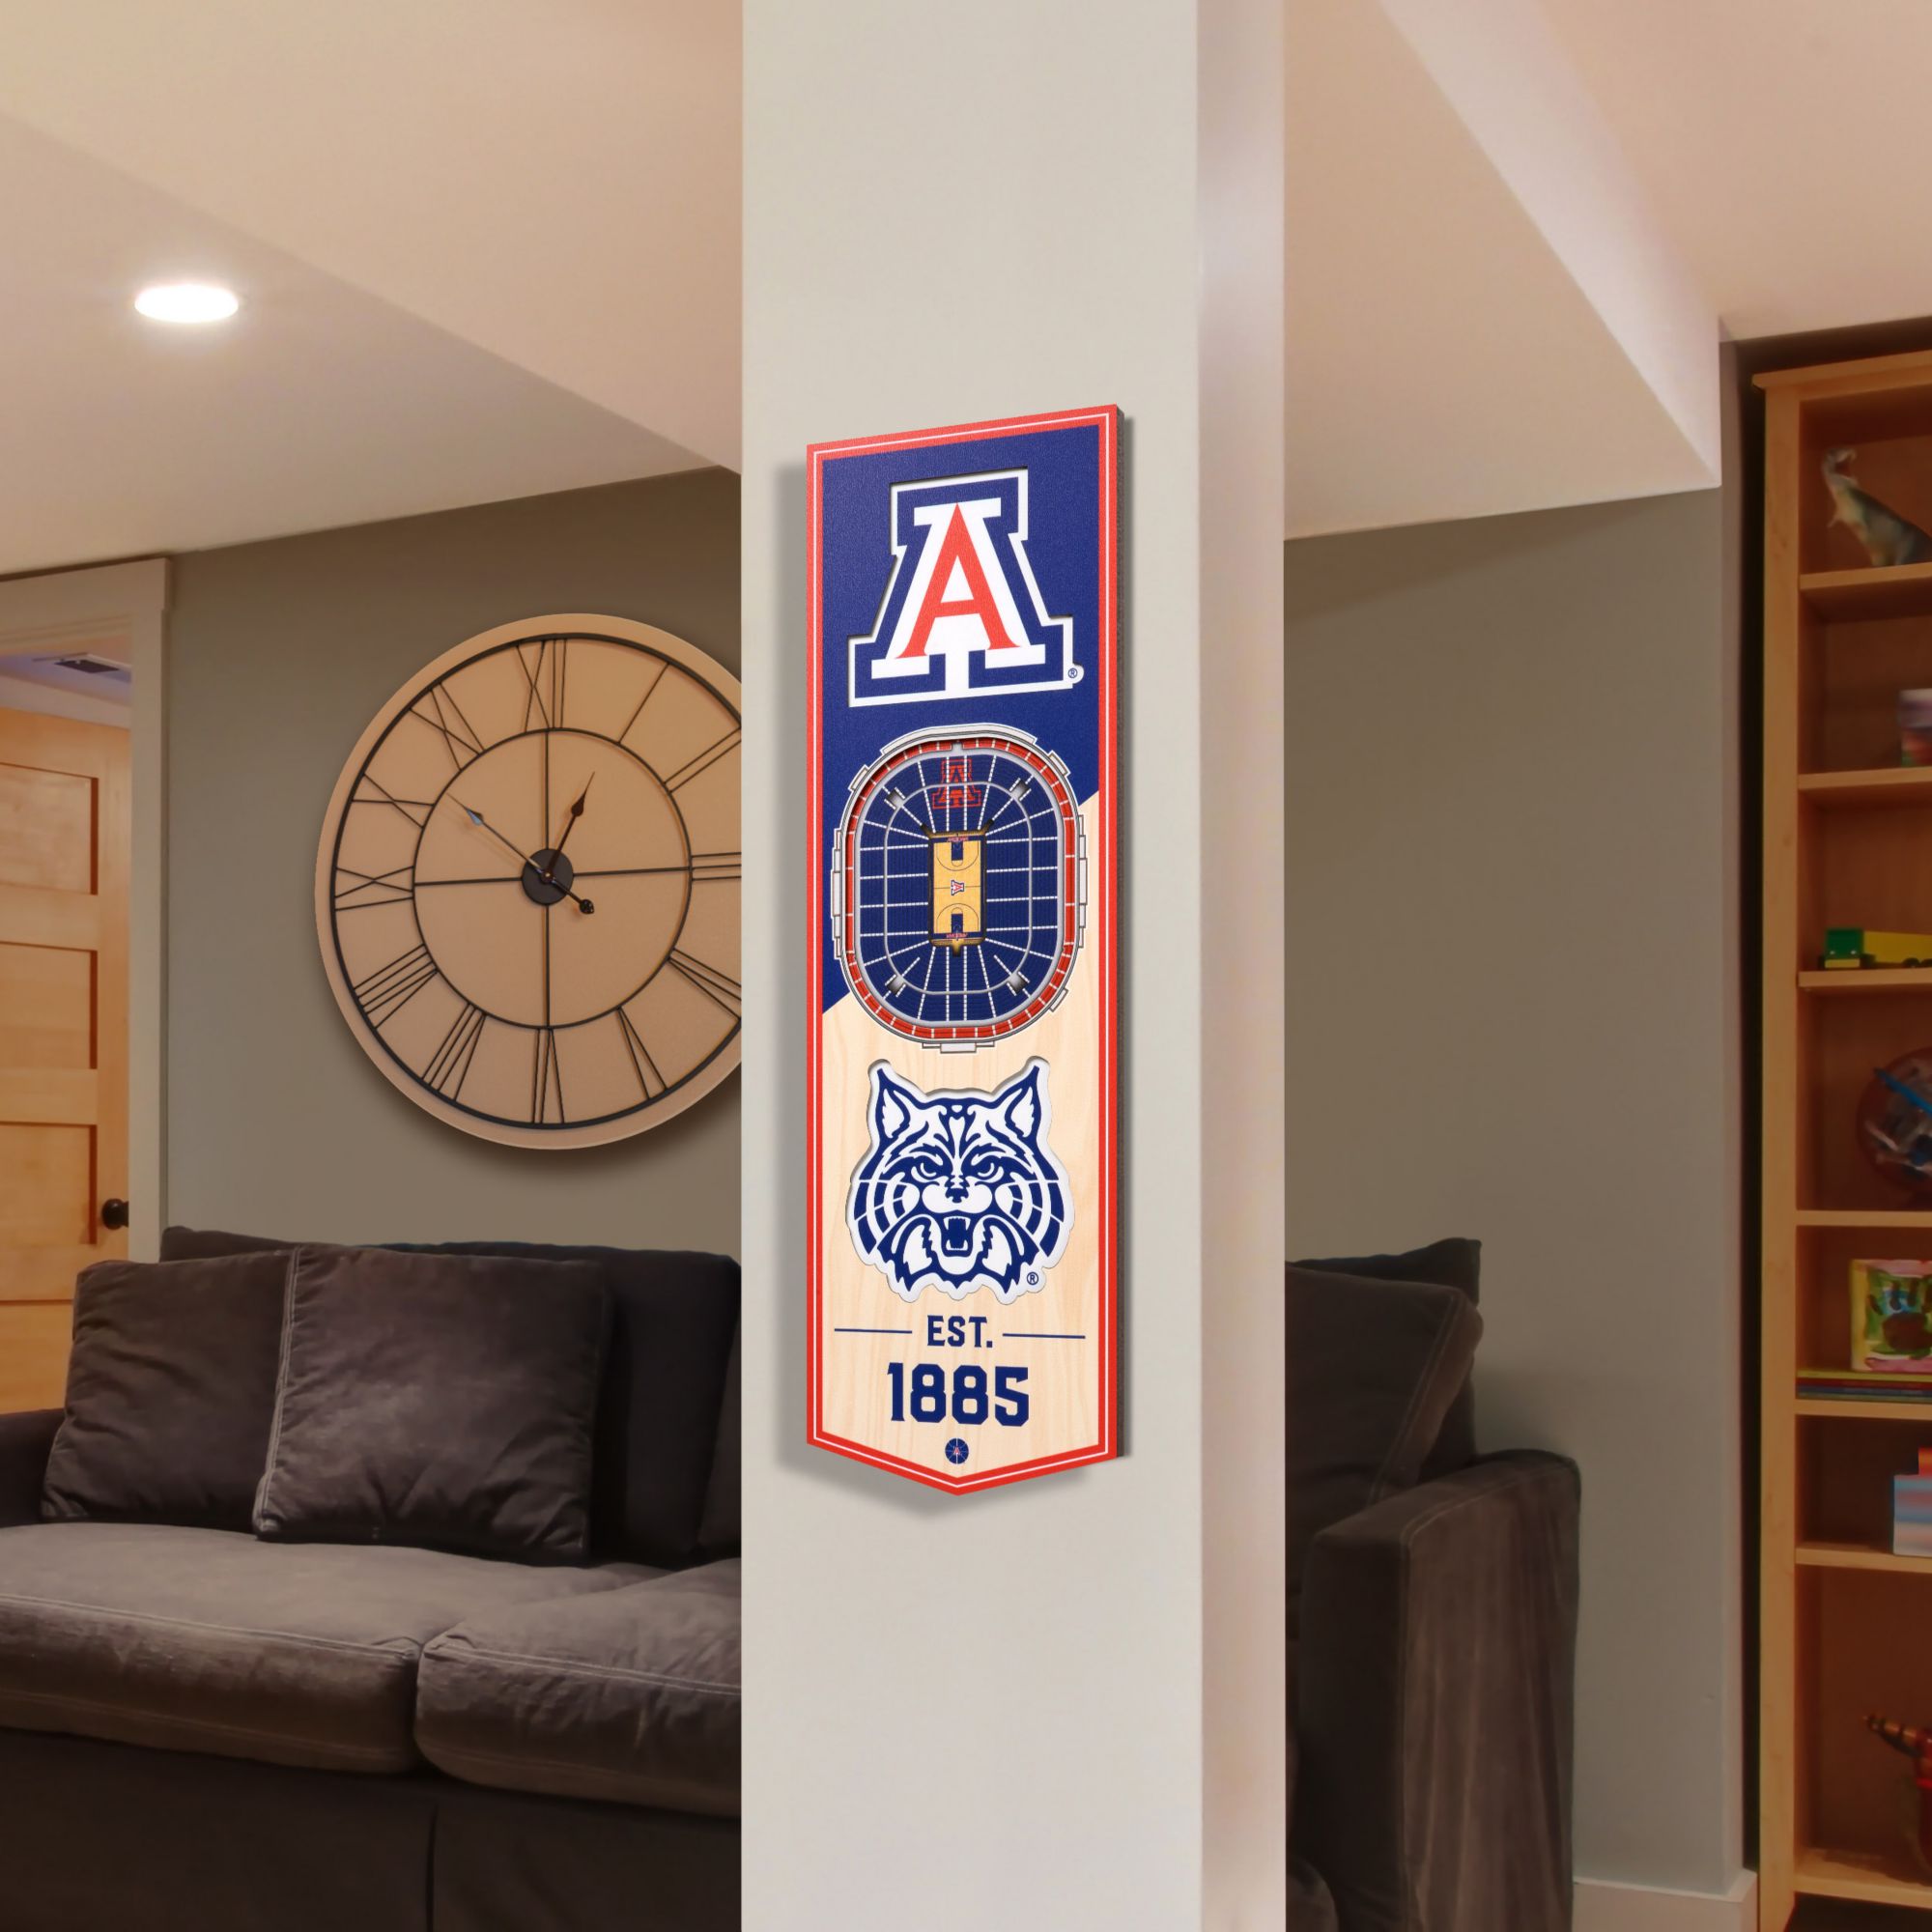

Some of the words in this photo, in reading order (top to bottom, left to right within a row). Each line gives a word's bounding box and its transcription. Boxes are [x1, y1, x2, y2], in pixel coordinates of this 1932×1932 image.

[848, 469, 1073, 707] A
[515, 639, 568, 733] XII
[409, 681, 486, 772] XI
[351, 773, 436, 829] X
[927, 1315, 993, 1349] EST.
[887, 1362, 1030, 1427] 1885
